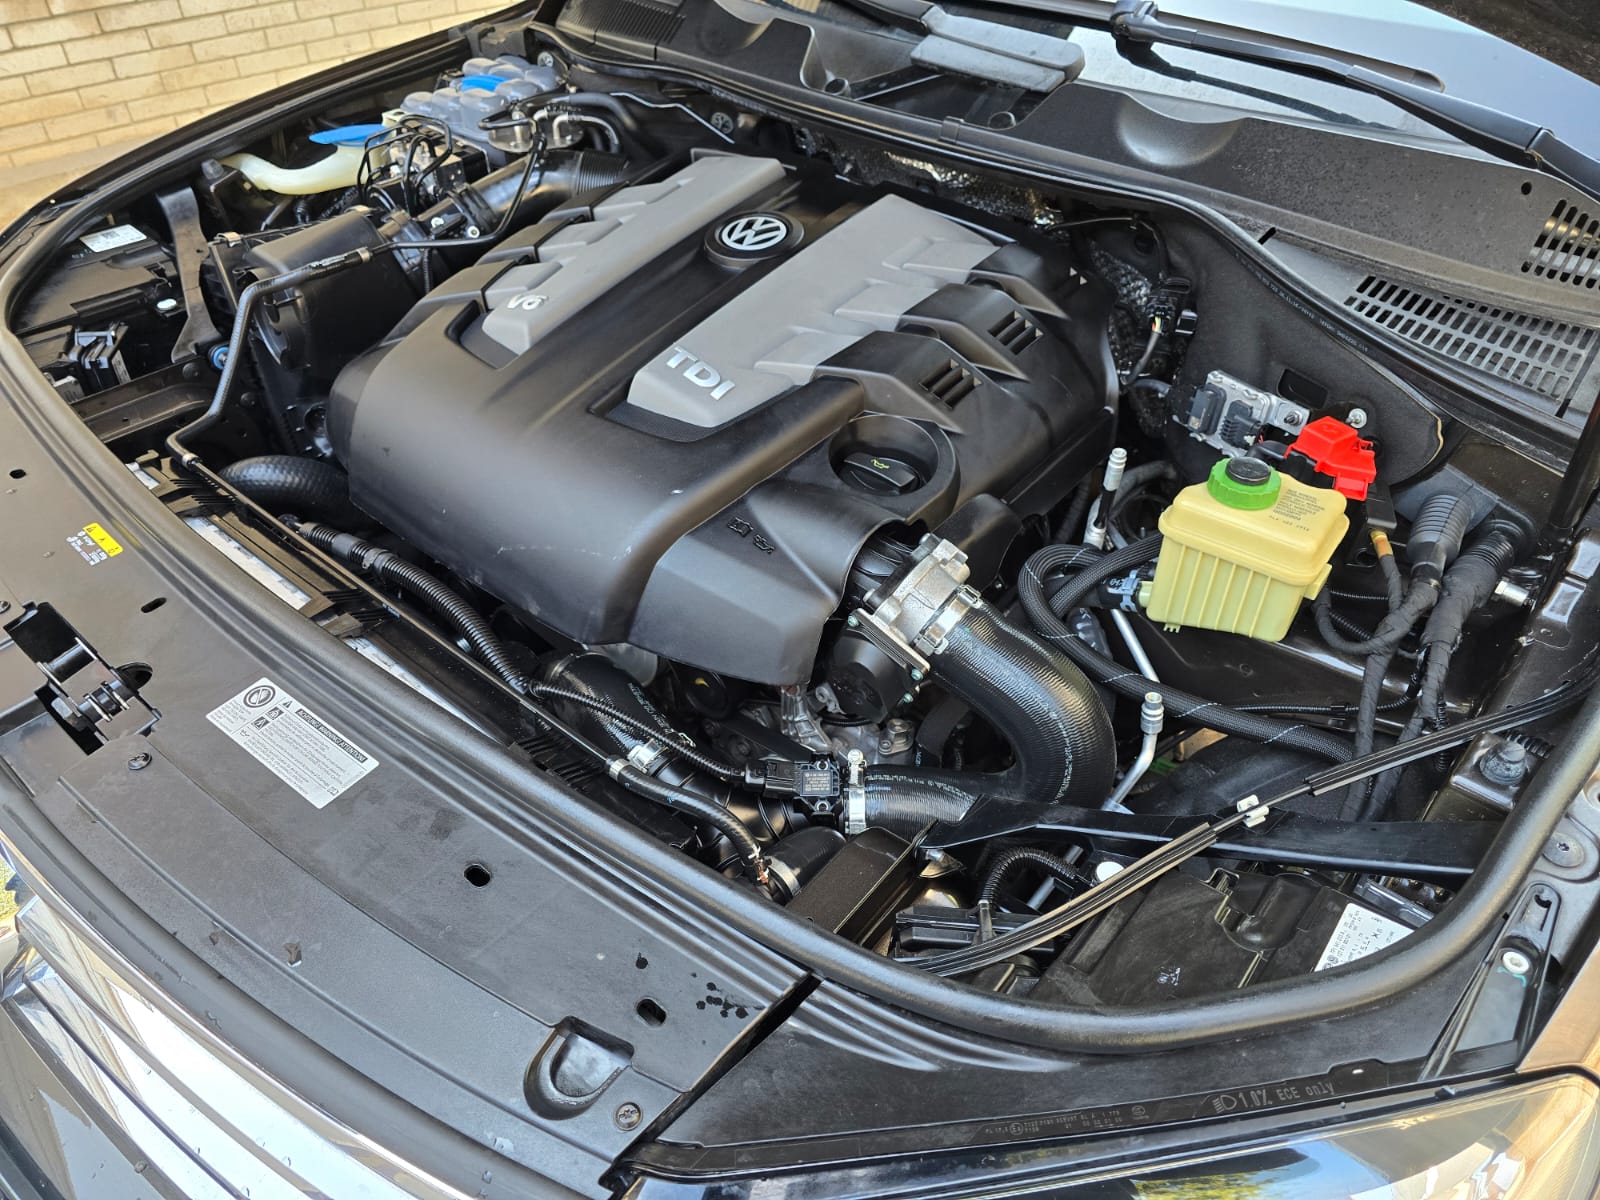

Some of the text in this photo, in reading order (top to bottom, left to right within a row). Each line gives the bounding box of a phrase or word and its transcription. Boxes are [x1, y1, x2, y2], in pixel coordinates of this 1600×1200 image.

[507, 294, 549, 310] V6
[667, 346, 735, 400] TDI
[1238, 1081, 1334, 1108] 1.0% ECE only
